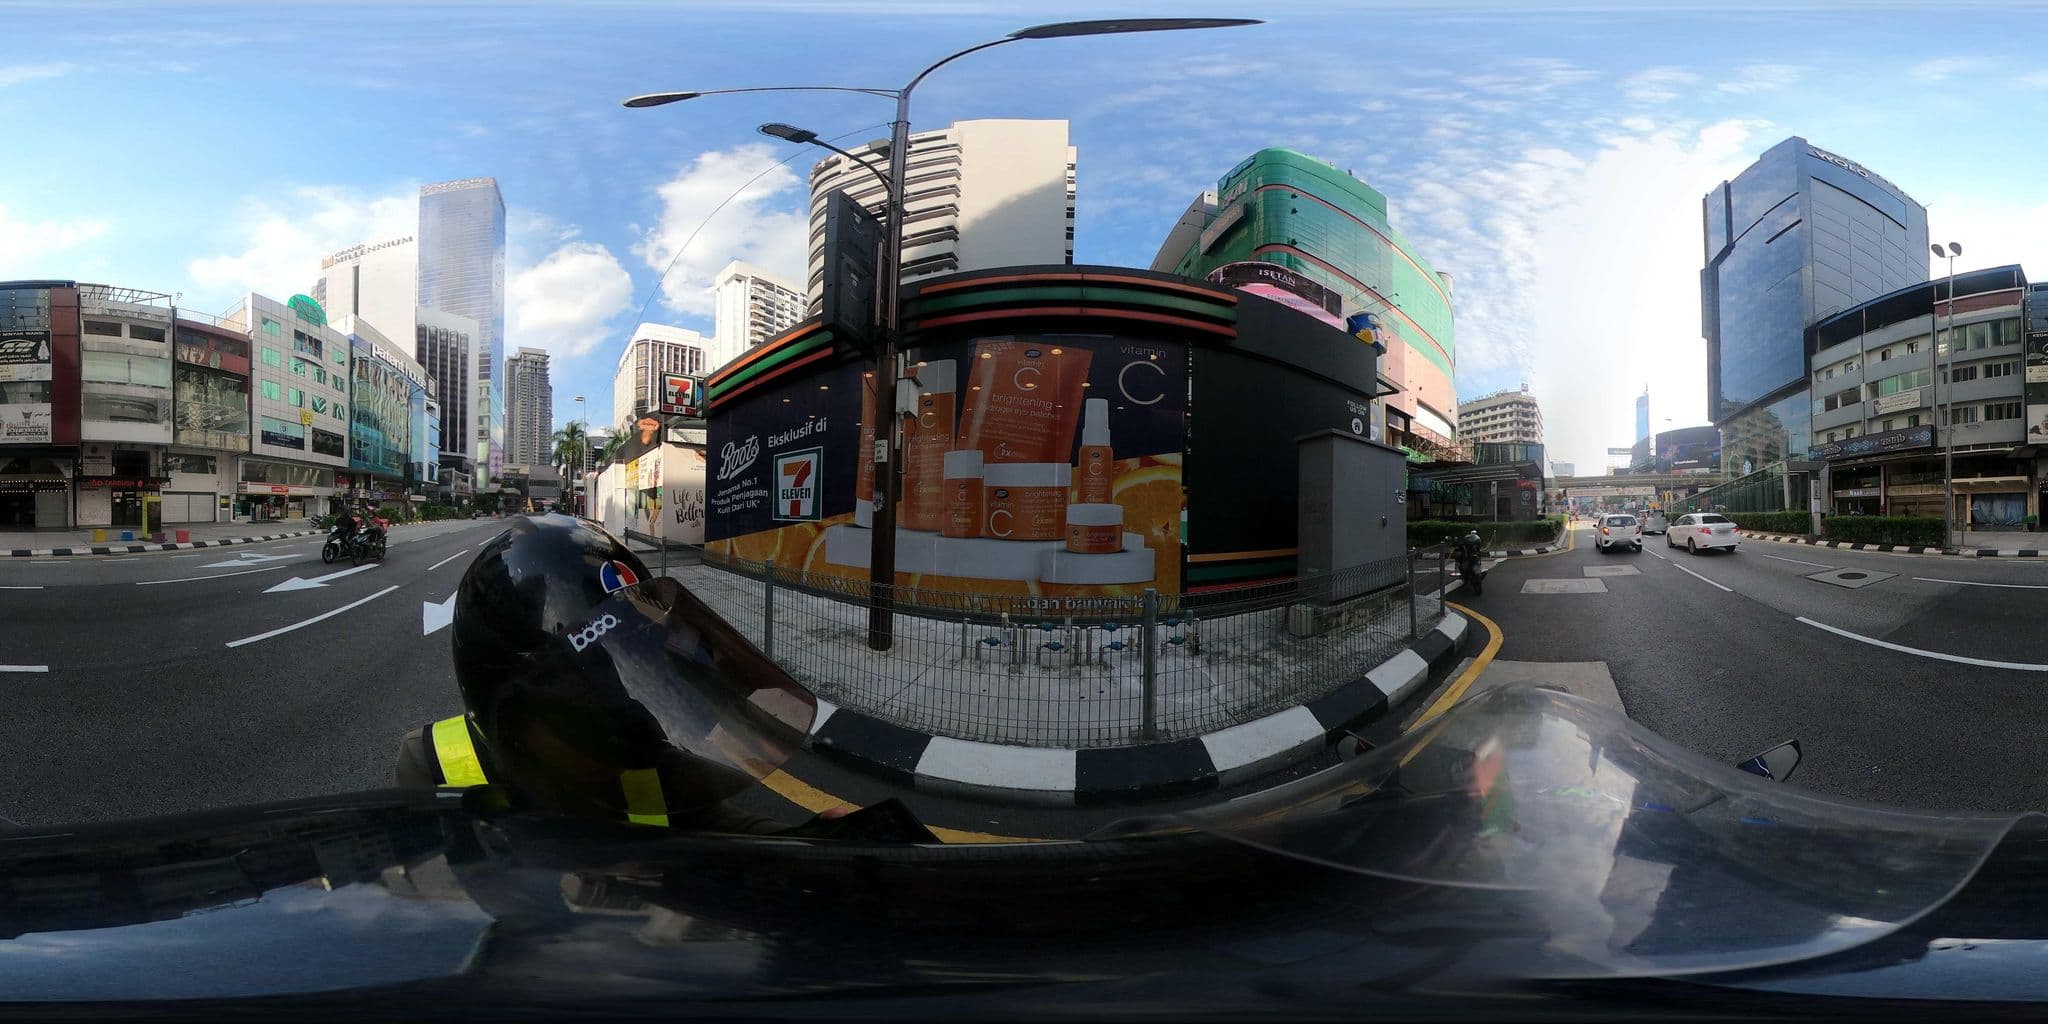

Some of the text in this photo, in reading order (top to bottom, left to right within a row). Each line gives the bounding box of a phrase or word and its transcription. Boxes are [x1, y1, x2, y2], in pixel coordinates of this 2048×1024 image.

[1813, 150, 1868, 178] WOLO
[334, 236, 414, 264] MILLENNIUM
[1259, 269, 1296, 285] ISETAN
[372, 343, 405, 373] patent
[1120, 344, 1167, 359] vitamin
[1014, 366, 1041, 391] C
[1119, 360, 1165, 405] C
[992, 393, 1053, 410] brightening
[767, 417, 827, 448] Eksklusif di
[717, 434, 760, 481] Boots
[672, 488, 704, 510] Life is
[711, 488, 769, 507] Produk Penjagaan
[718, 477, 758, 497] Jenama No.1
[783, 459, 812, 518] 7
[675, 501, 704, 524] Better
[717, 505, 731, 514] Kulit
[731, 502, 745, 511] Dari
